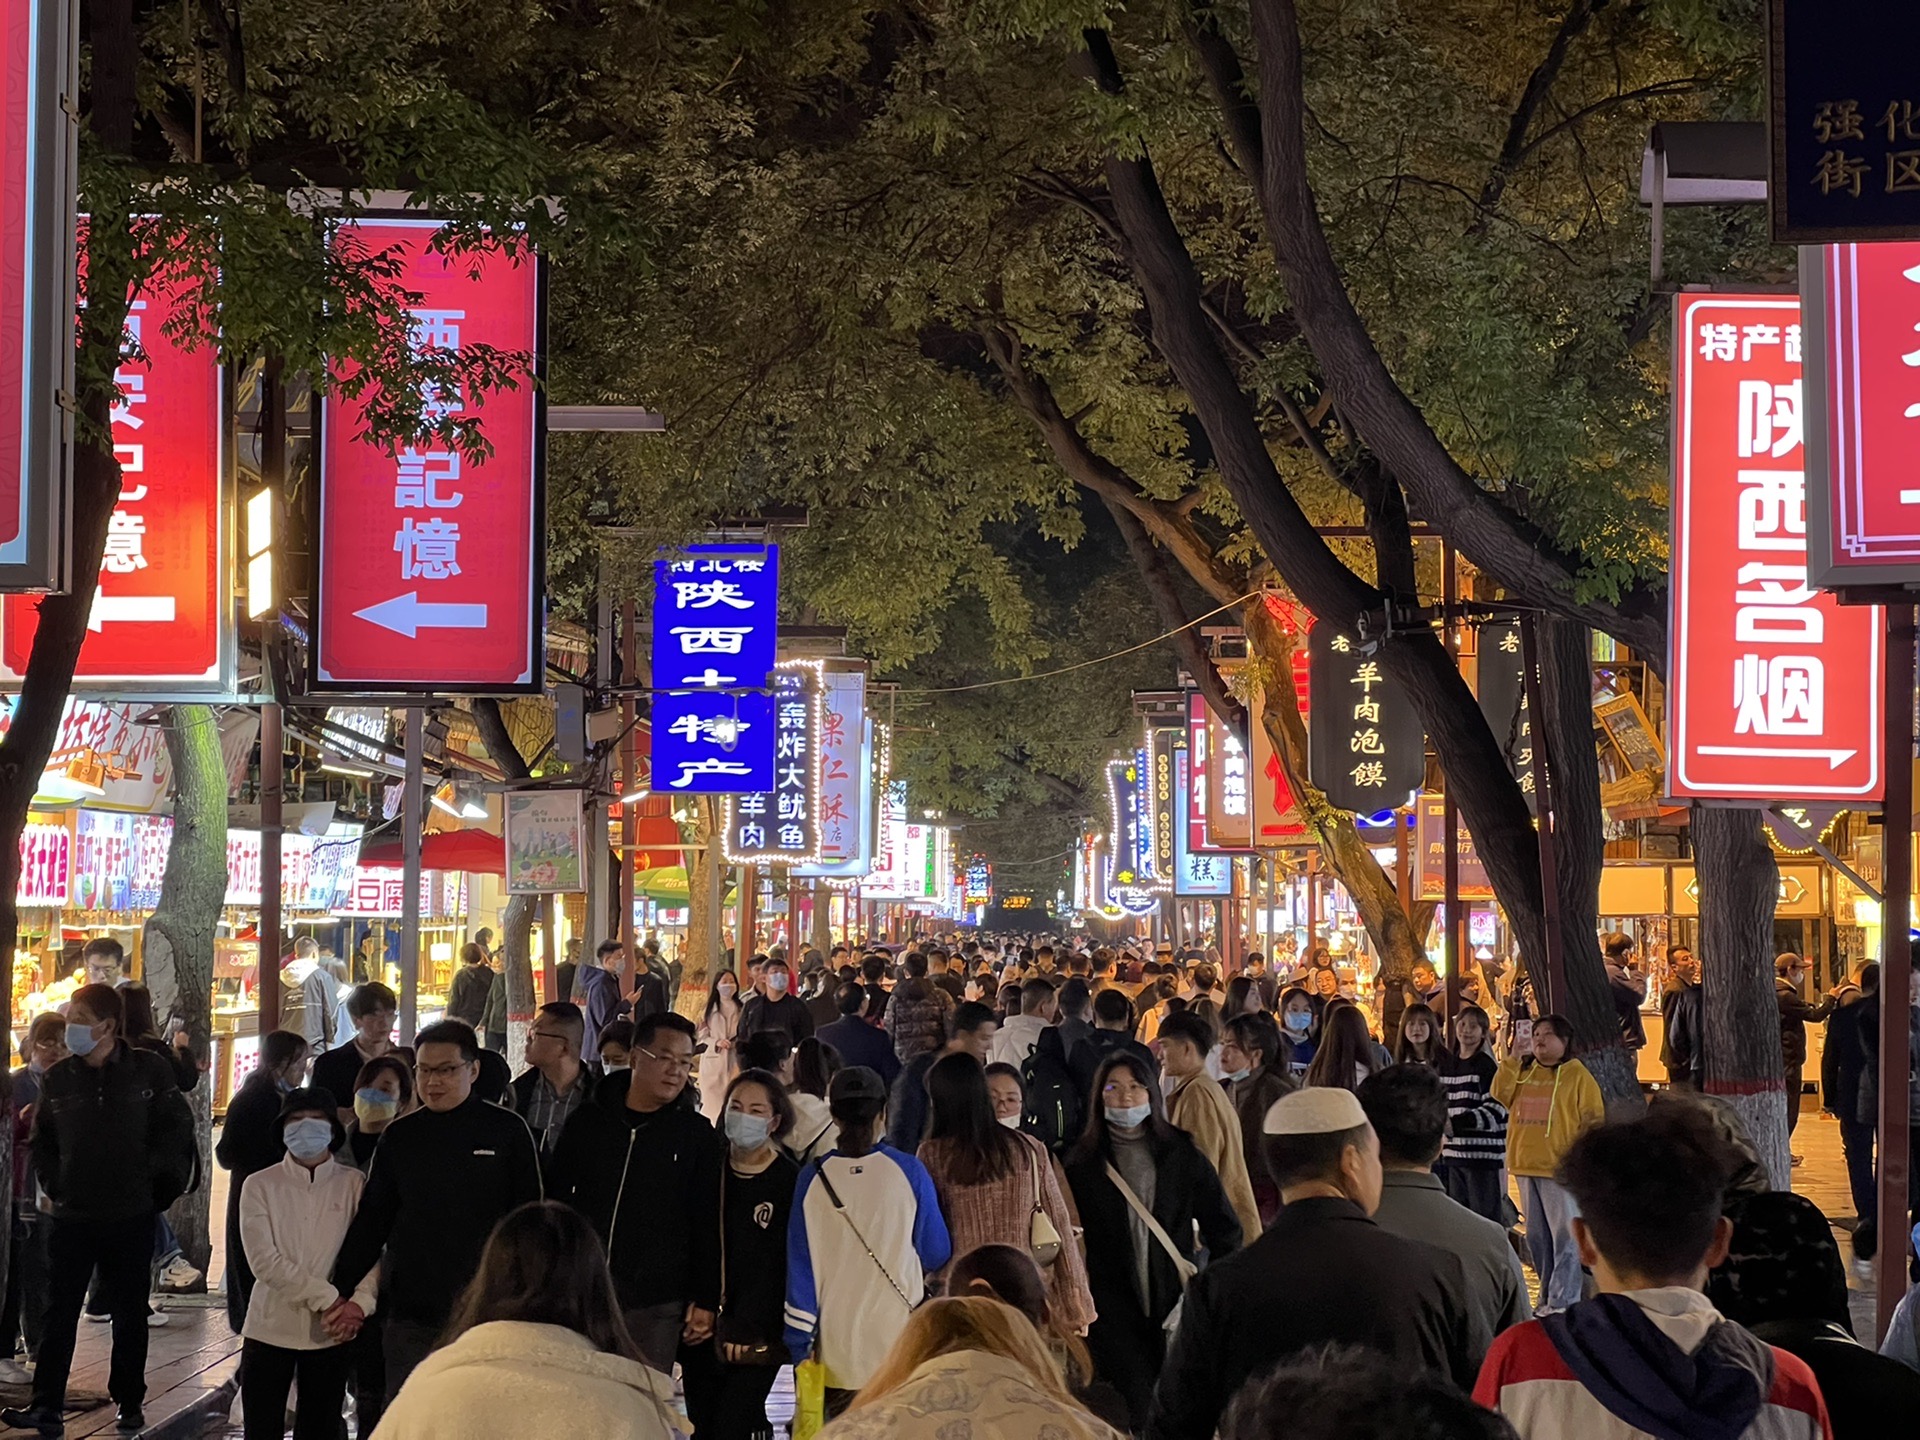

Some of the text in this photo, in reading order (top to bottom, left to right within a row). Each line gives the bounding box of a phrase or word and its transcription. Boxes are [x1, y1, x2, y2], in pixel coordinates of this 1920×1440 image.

[1810, 149, 1920, 197] 街区
[1734, 379, 1825, 736] 陕西名烟
[669, 579, 755, 787] 陕西土特产
[777, 702, 807, 850] 轰炸大鱿鱼
